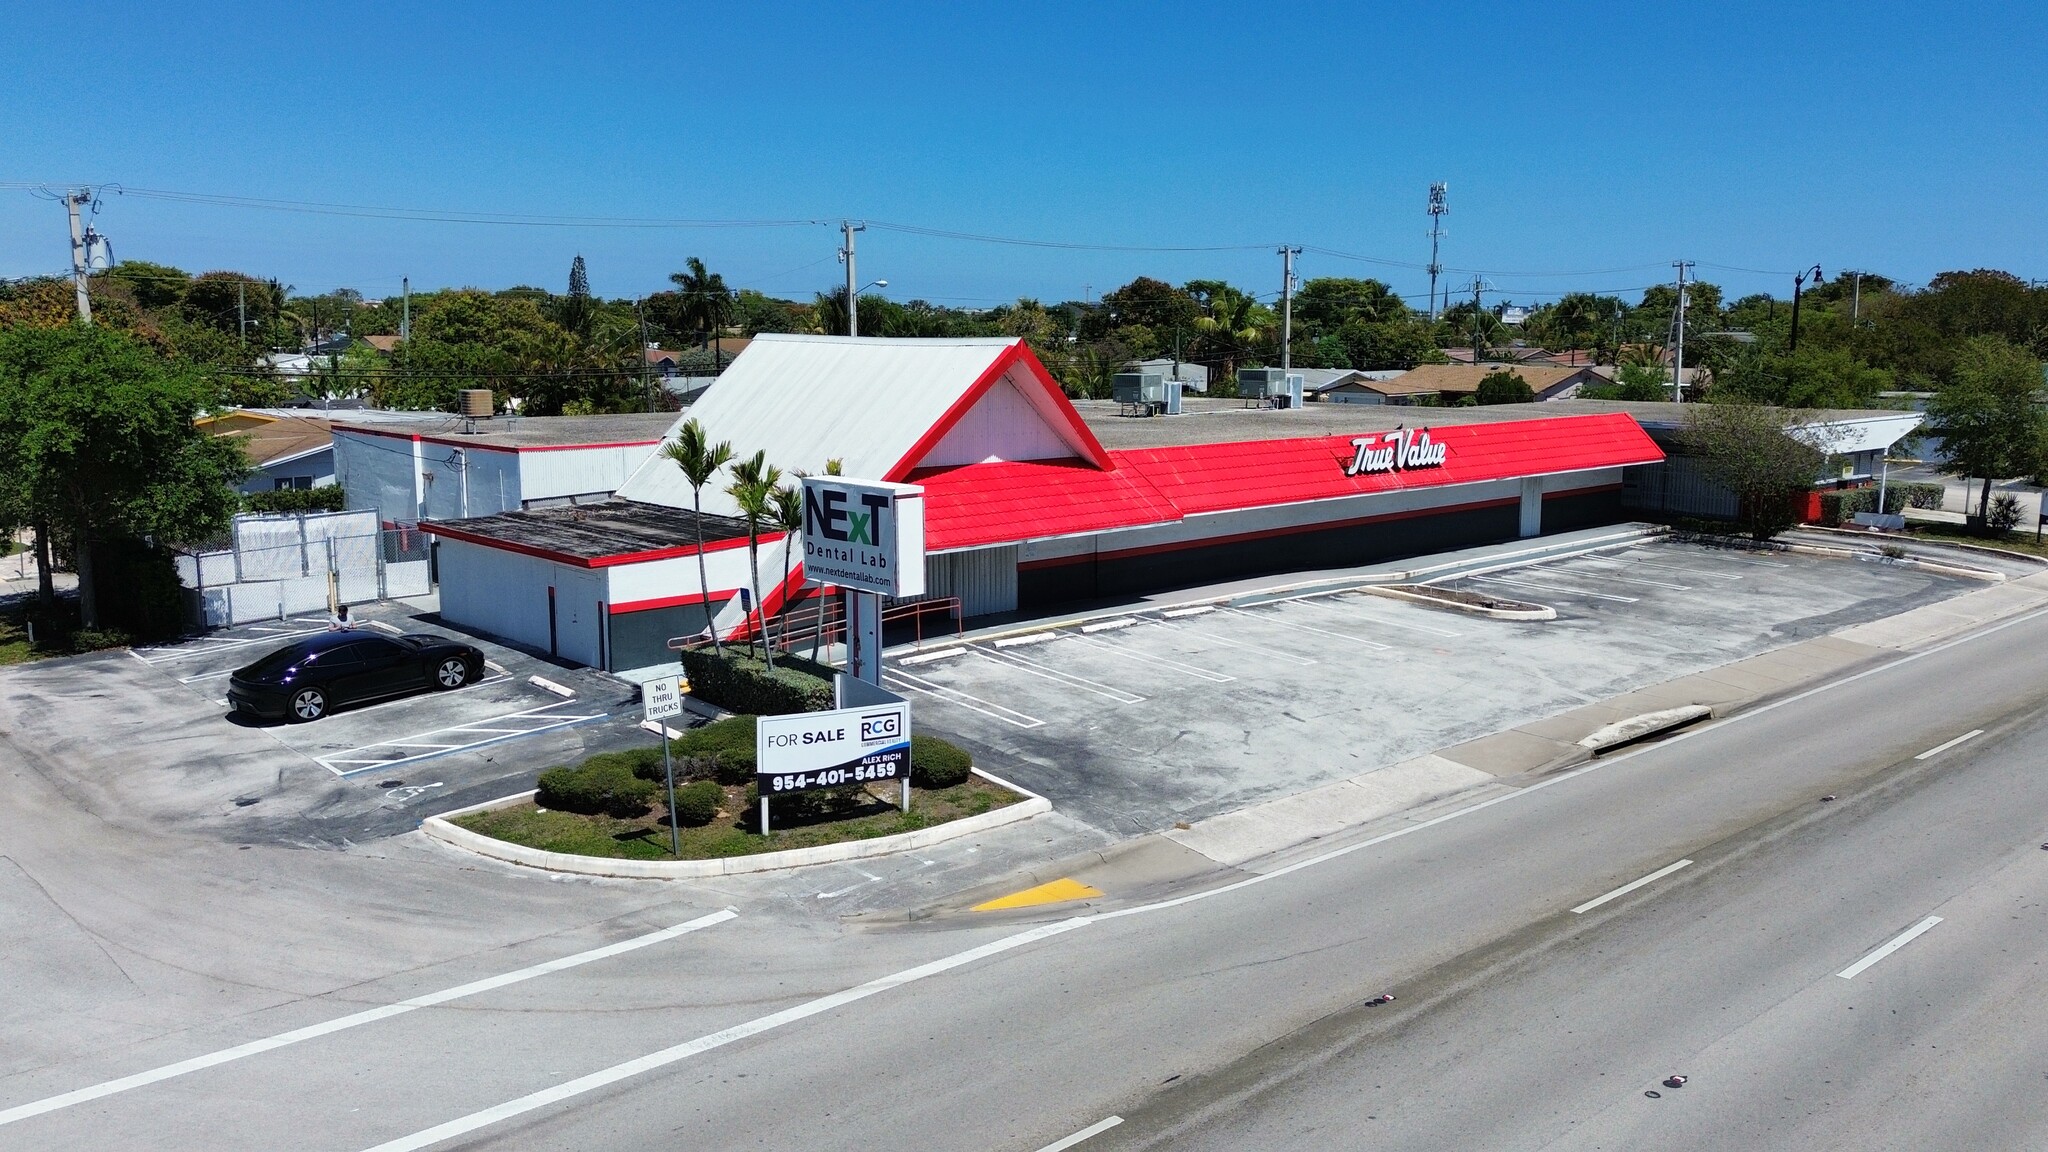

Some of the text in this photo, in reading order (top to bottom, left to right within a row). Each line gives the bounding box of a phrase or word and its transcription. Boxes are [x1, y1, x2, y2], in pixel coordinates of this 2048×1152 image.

[1347, 428, 1446, 475] True Value
[807, 541, 887, 568] Dental Lab
[807, 564, 891, 587] www.nextdentallab.com
[655, 683, 667, 692] NO
[652, 693, 673, 703] THRU
[648, 703, 679, 715] TRUCKS
[861, 719, 895, 735] RCG
[768, 728, 845, 748] FOR SALE
[861, 752, 902, 765] ALEX RICH
[772, 762, 896, 792] 954-401-5459
